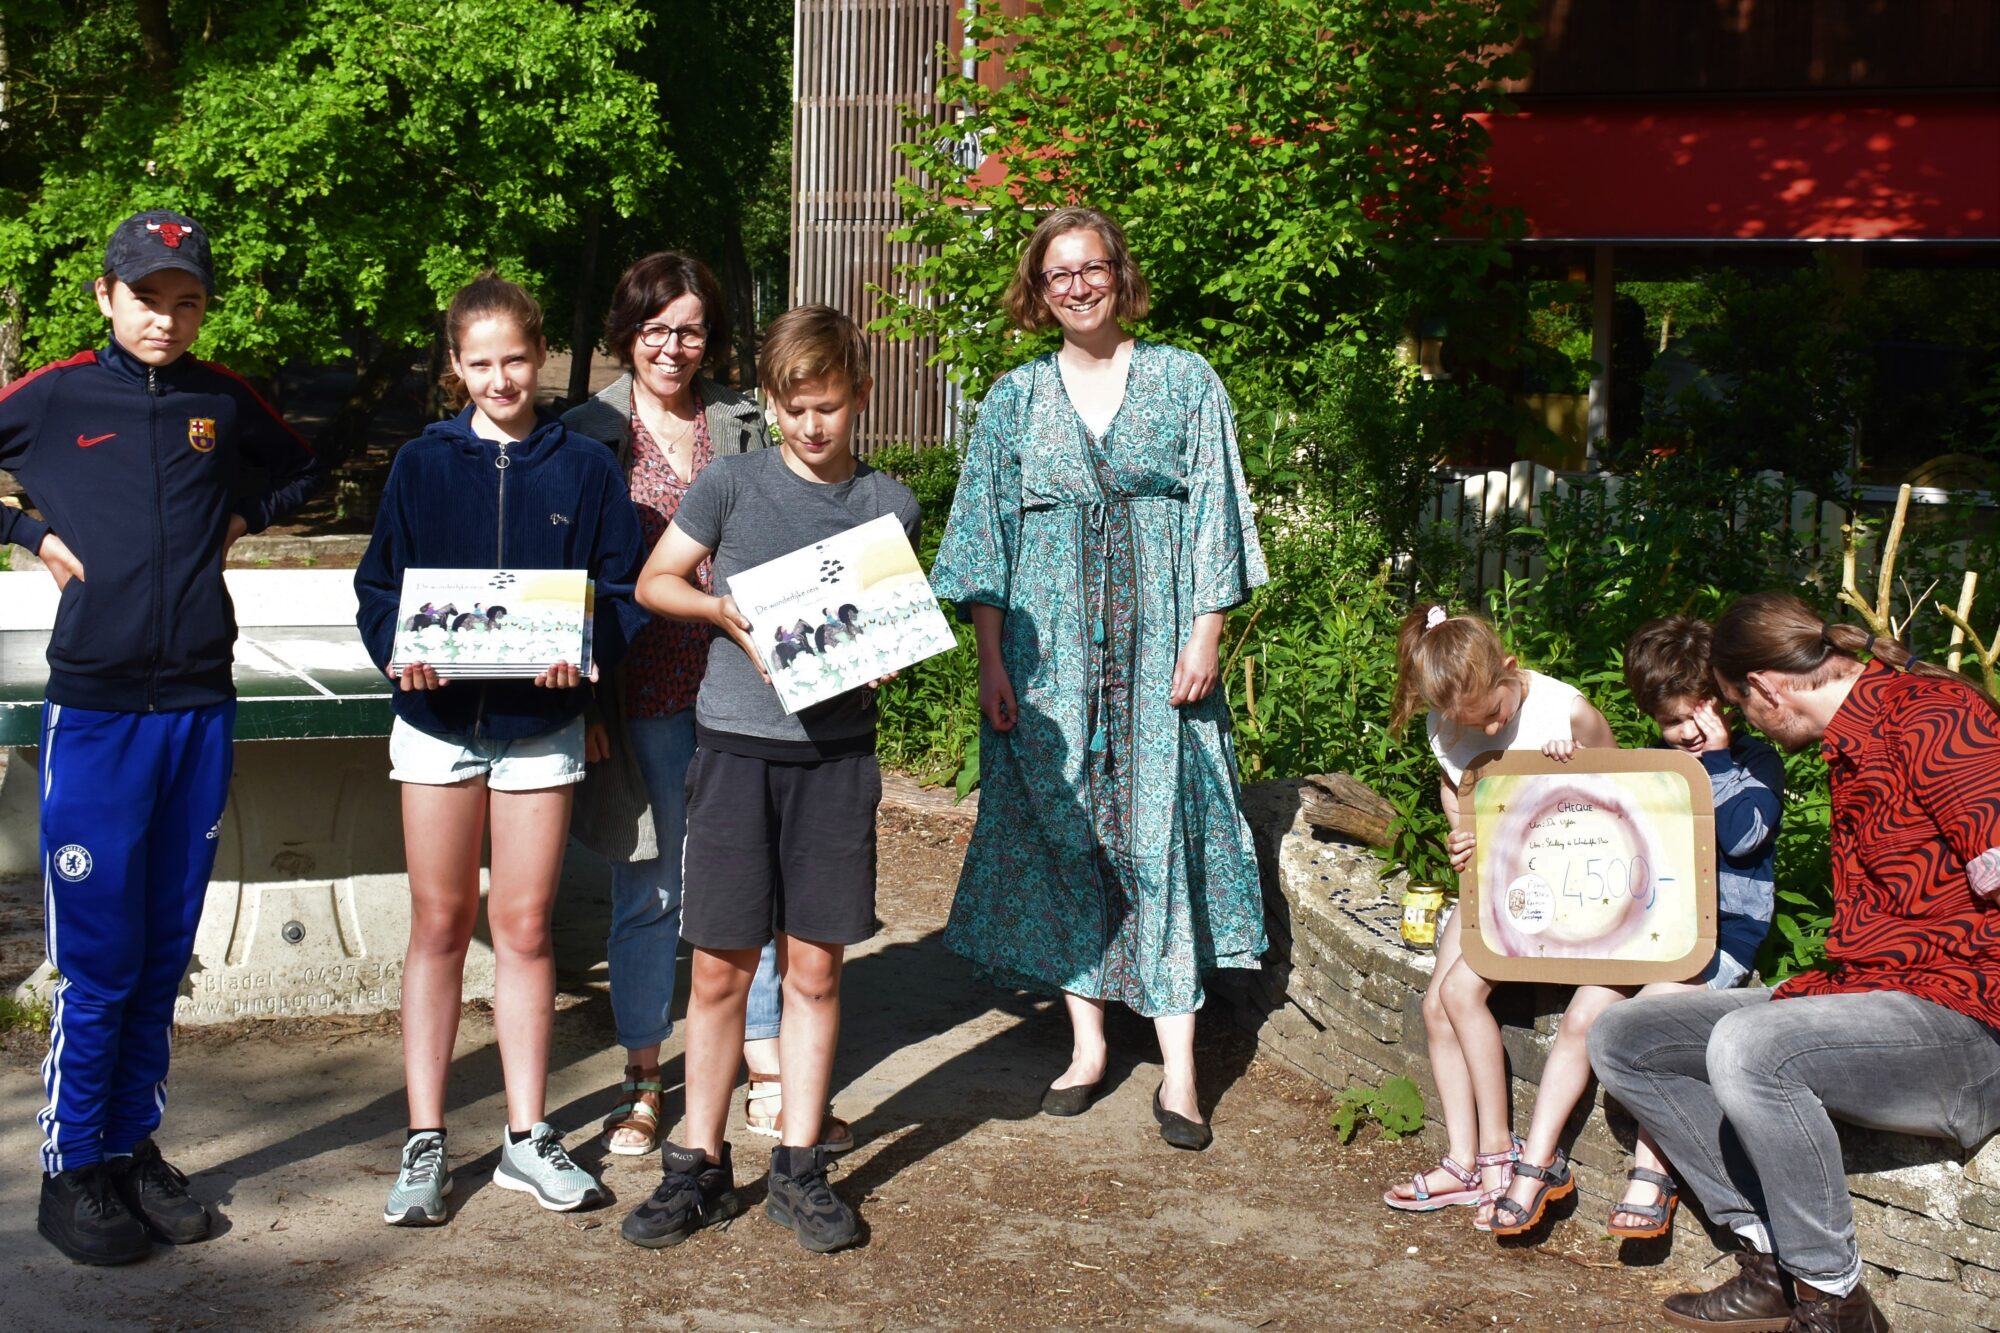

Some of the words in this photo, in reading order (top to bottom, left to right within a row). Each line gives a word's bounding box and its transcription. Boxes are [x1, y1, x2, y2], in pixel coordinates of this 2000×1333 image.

[755, 605, 768, 615] De
[61, 846, 87, 856] CHELSEA
[1528, 857, 1536, 871] €
